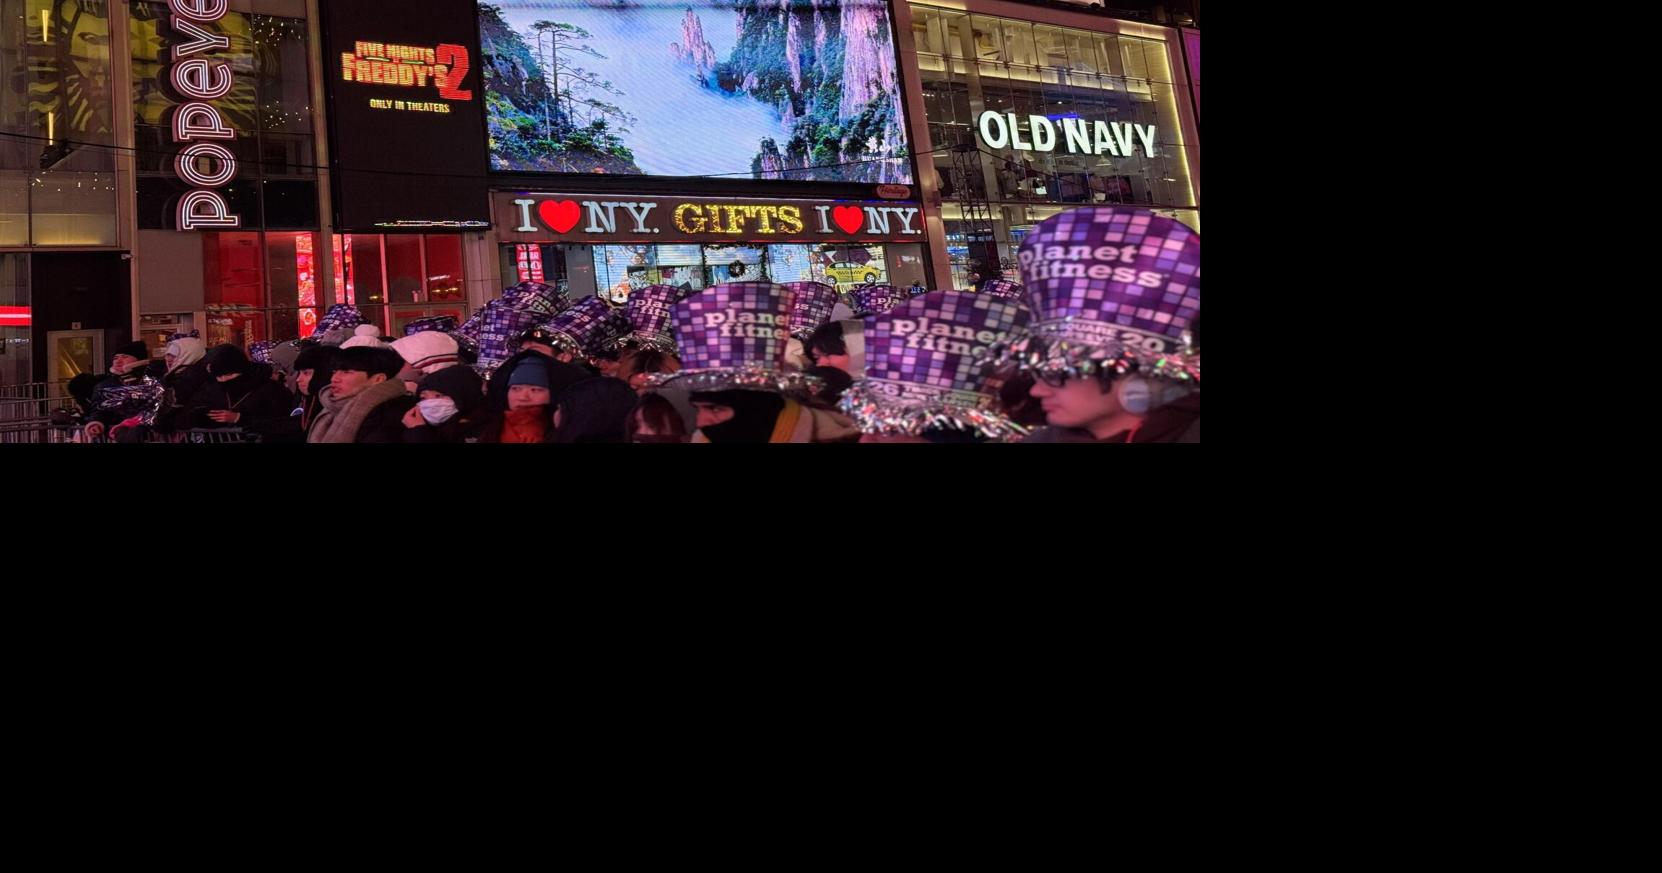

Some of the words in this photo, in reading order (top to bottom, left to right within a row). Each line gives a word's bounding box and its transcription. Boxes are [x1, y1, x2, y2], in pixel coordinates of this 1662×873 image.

[355, 40, 385, 57] FIVE
[385, 44, 435, 64] NIGHTS
[342, 52, 448, 88] FREDDY'S
[436, 43, 472, 100] 2
[369, 98, 393, 109] ONLY
[394, 100, 405, 110] IN
[406, 101, 450, 113] THEATERS
[979, 110, 1056, 152] OLD
[1062, 117, 1156, 158] NAVY
[514, 199, 538, 232] I
[582, 201, 660, 234] NY.
[673, 203, 804, 235] GIFTS
[815, 205, 835, 234] I
[863, 206, 922, 235] NY.
[1018, 243, 1138, 270] planet
[1030, 260, 1163, 288] fitness
